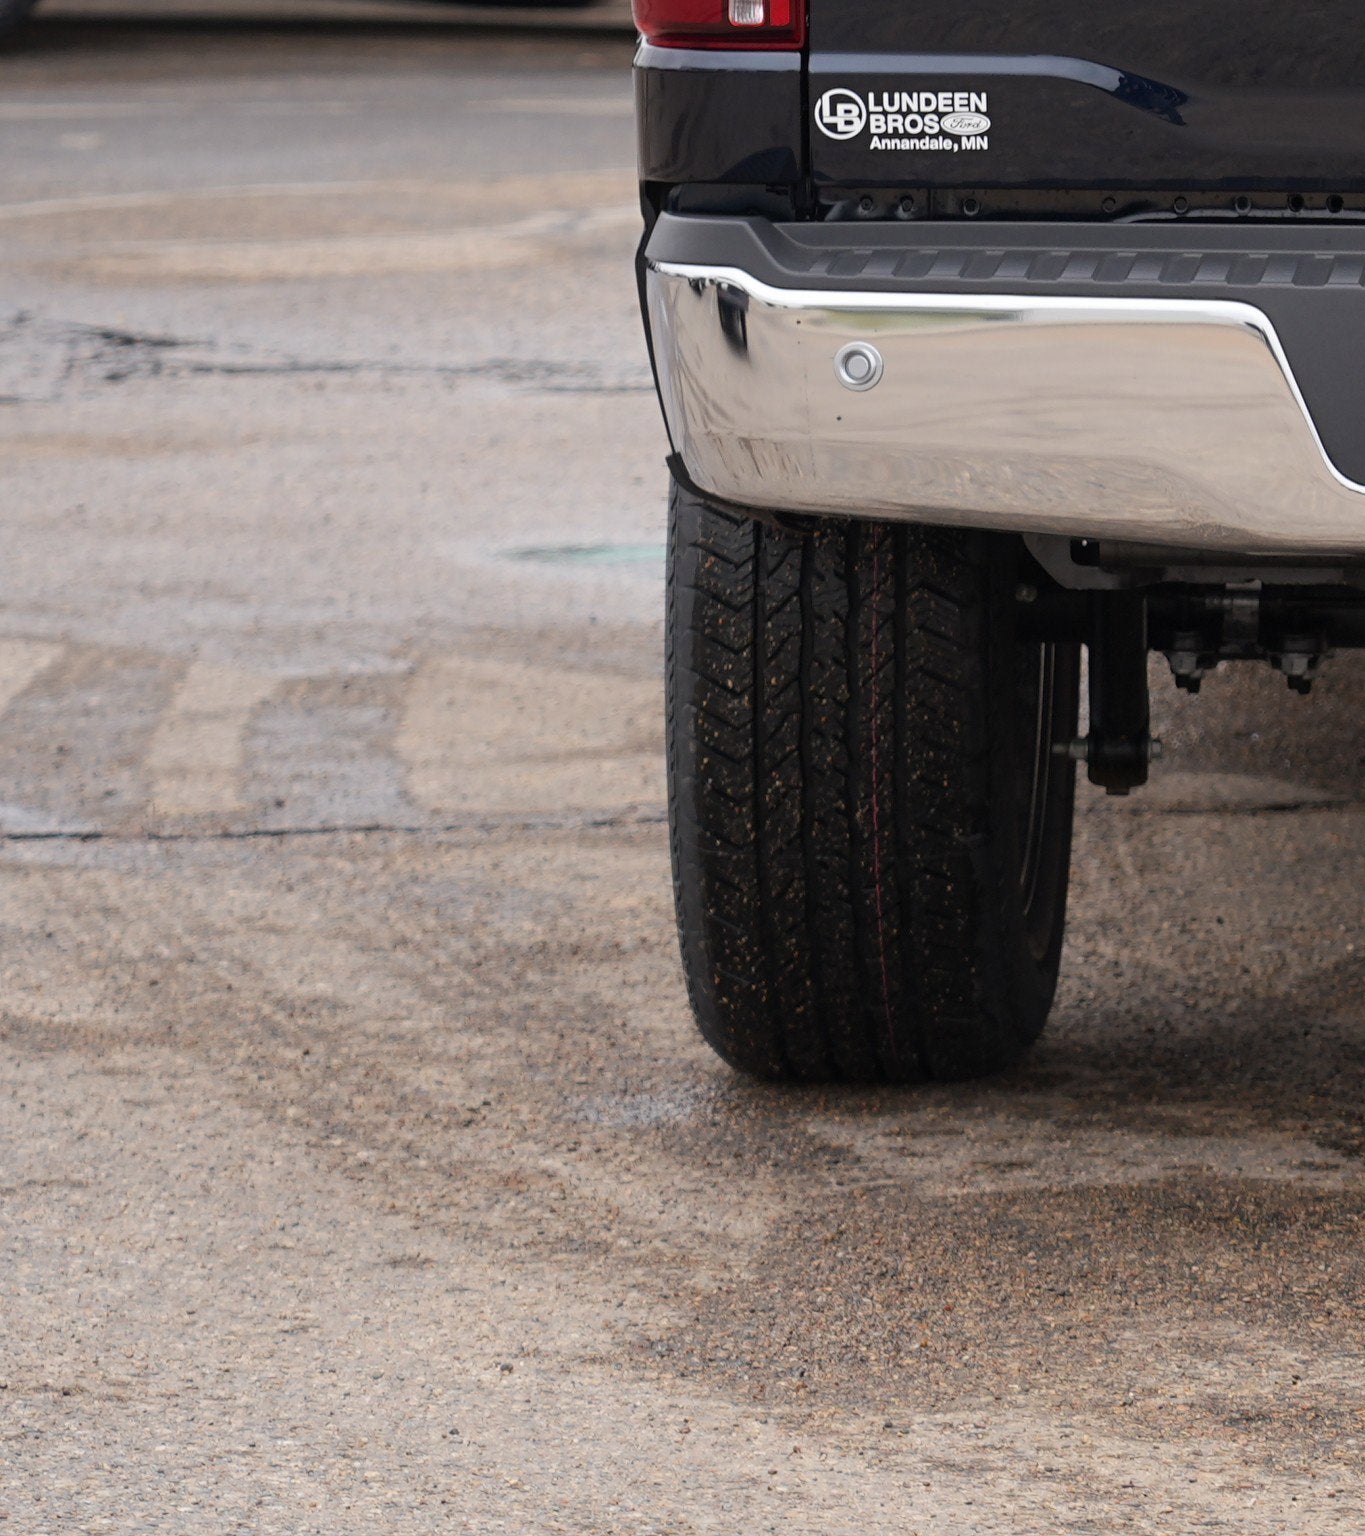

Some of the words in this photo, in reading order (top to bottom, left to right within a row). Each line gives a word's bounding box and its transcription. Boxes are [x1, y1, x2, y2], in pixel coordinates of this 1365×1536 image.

[868, 91, 988, 113] LUNDEEN
[869, 113, 941, 135] BROS
[869, 135, 958, 153] Annandale,
[961, 136, 989, 151] MN
